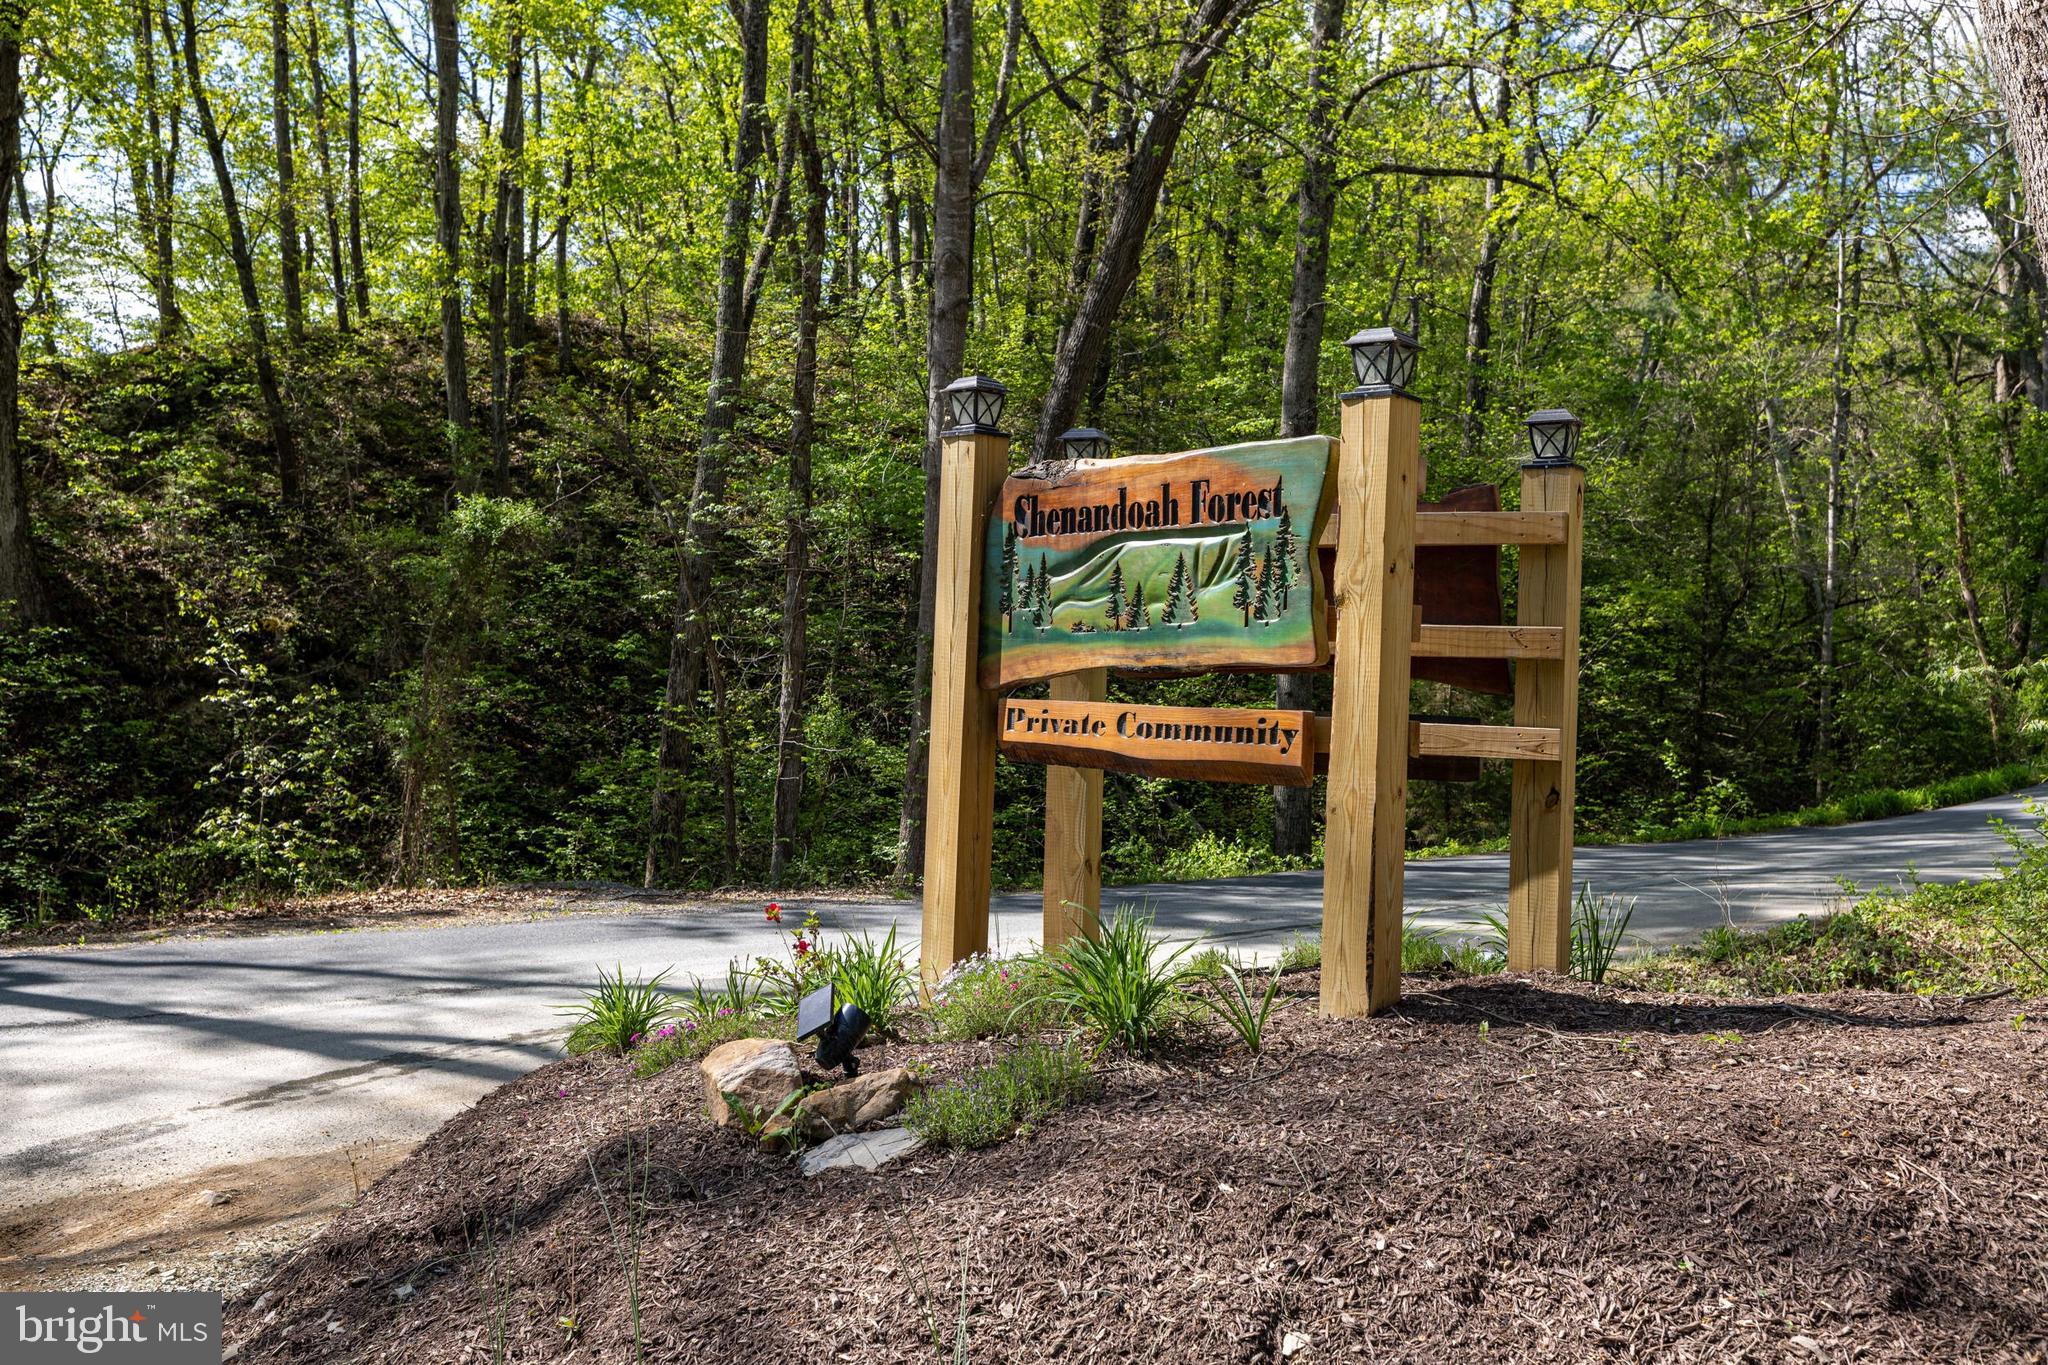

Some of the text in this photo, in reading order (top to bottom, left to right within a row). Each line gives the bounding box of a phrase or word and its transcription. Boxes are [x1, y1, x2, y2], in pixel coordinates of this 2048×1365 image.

[1013, 474, 1285, 538] Shenandoah Forest
[1006, 707, 1299, 755] Private Community
